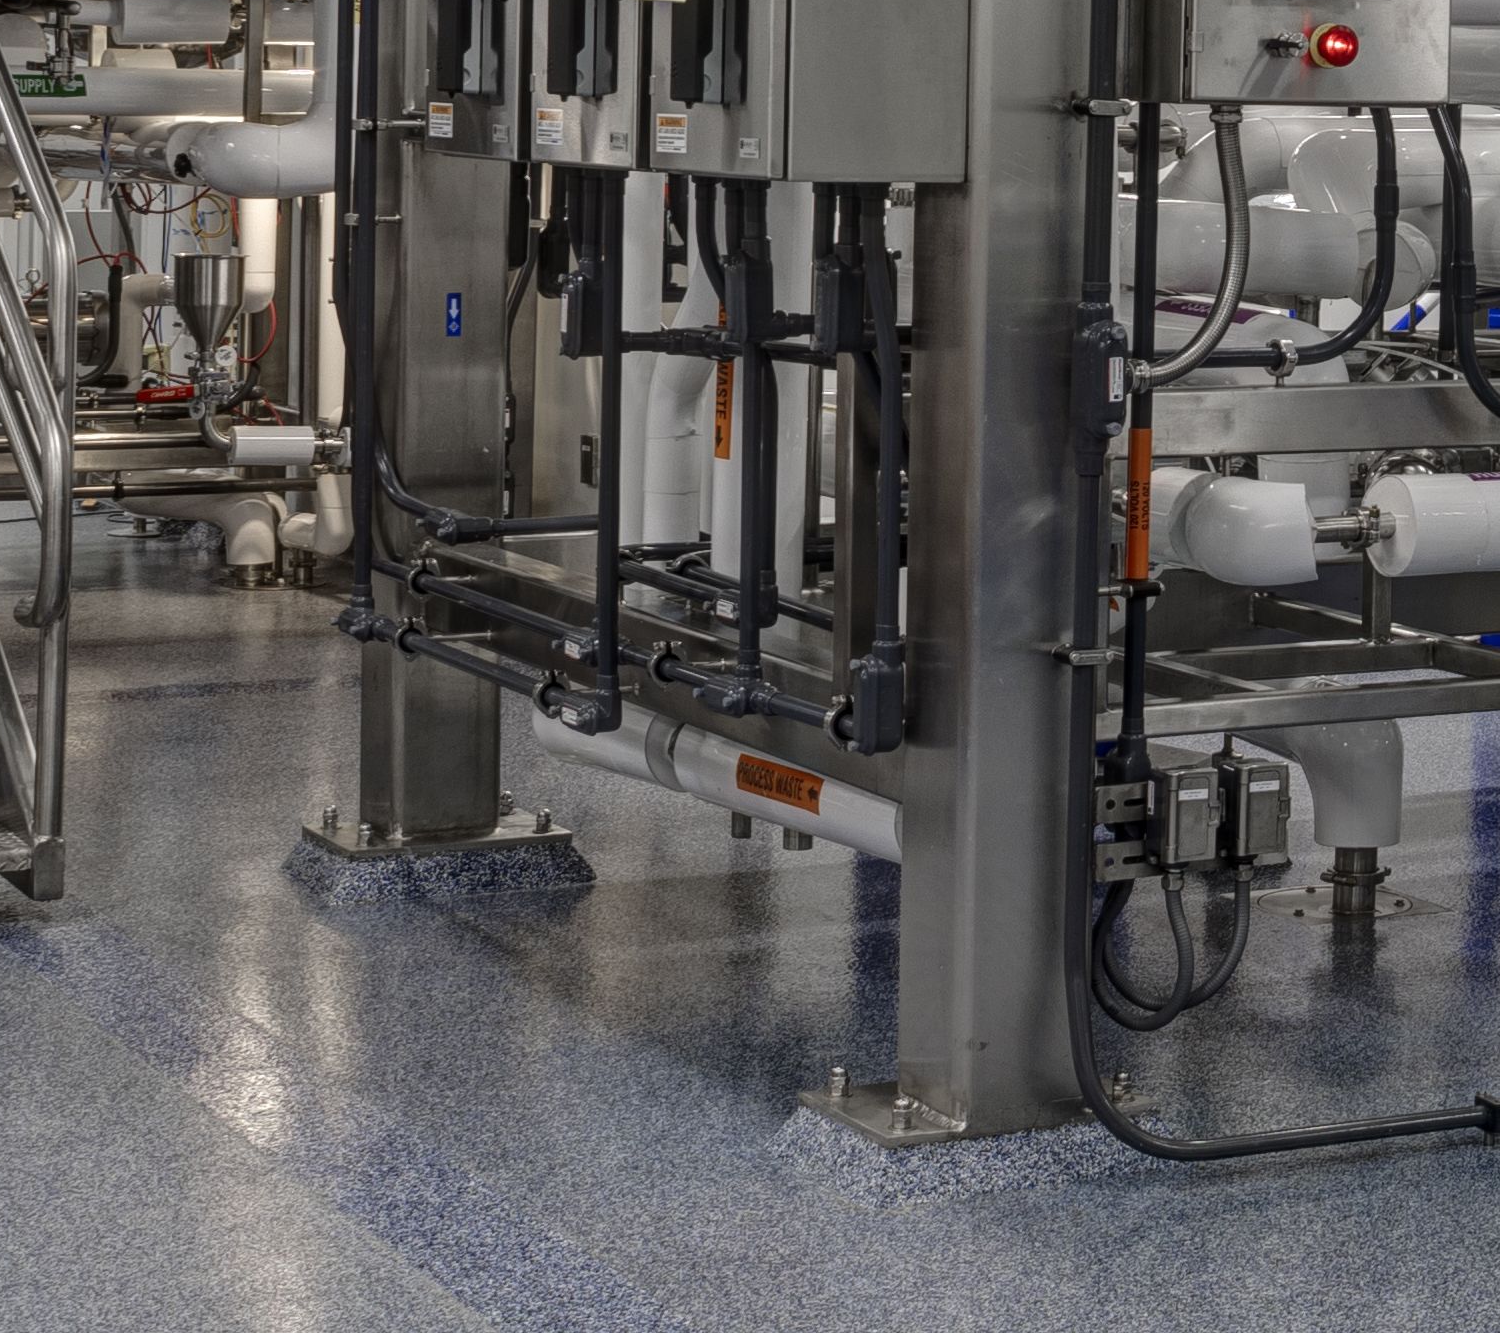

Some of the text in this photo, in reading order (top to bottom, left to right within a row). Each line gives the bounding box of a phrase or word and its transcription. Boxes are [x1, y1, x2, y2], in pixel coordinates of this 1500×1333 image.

[715, 361, 730, 420] WASTE
[1131, 481, 1140, 530] 120 VOLTS
[739, 761, 804, 801] PROCESS WASTE
